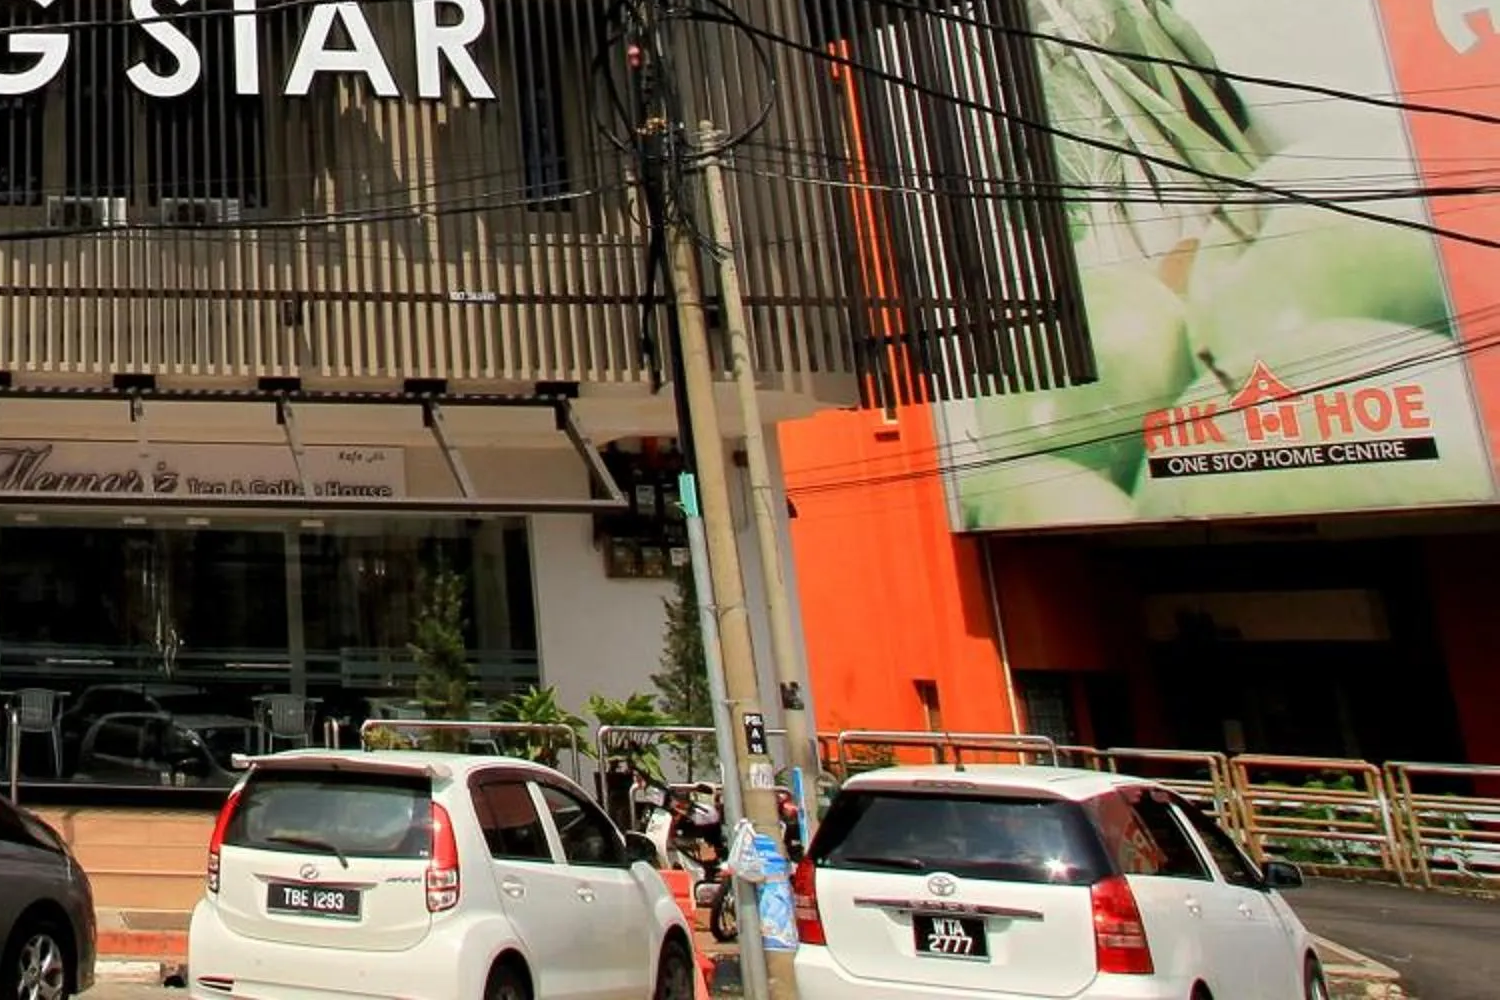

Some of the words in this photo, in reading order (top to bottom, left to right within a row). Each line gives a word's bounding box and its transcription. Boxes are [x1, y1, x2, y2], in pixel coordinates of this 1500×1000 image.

[1314, 385, 1431, 441] HOE
[1167, 455, 1208, 475] ONE
[1212, 452, 1257, 473] STOP
[1262, 446, 1325, 468] HOME
[1327, 441, 1407, 463] CENTRE
[325, 482, 394, 498] House
[283, 887, 309, 908] TBE
[313, 890, 345, 910] 1293
[931, 917, 965, 937] WTA
[927, 935, 973, 954] 2777
